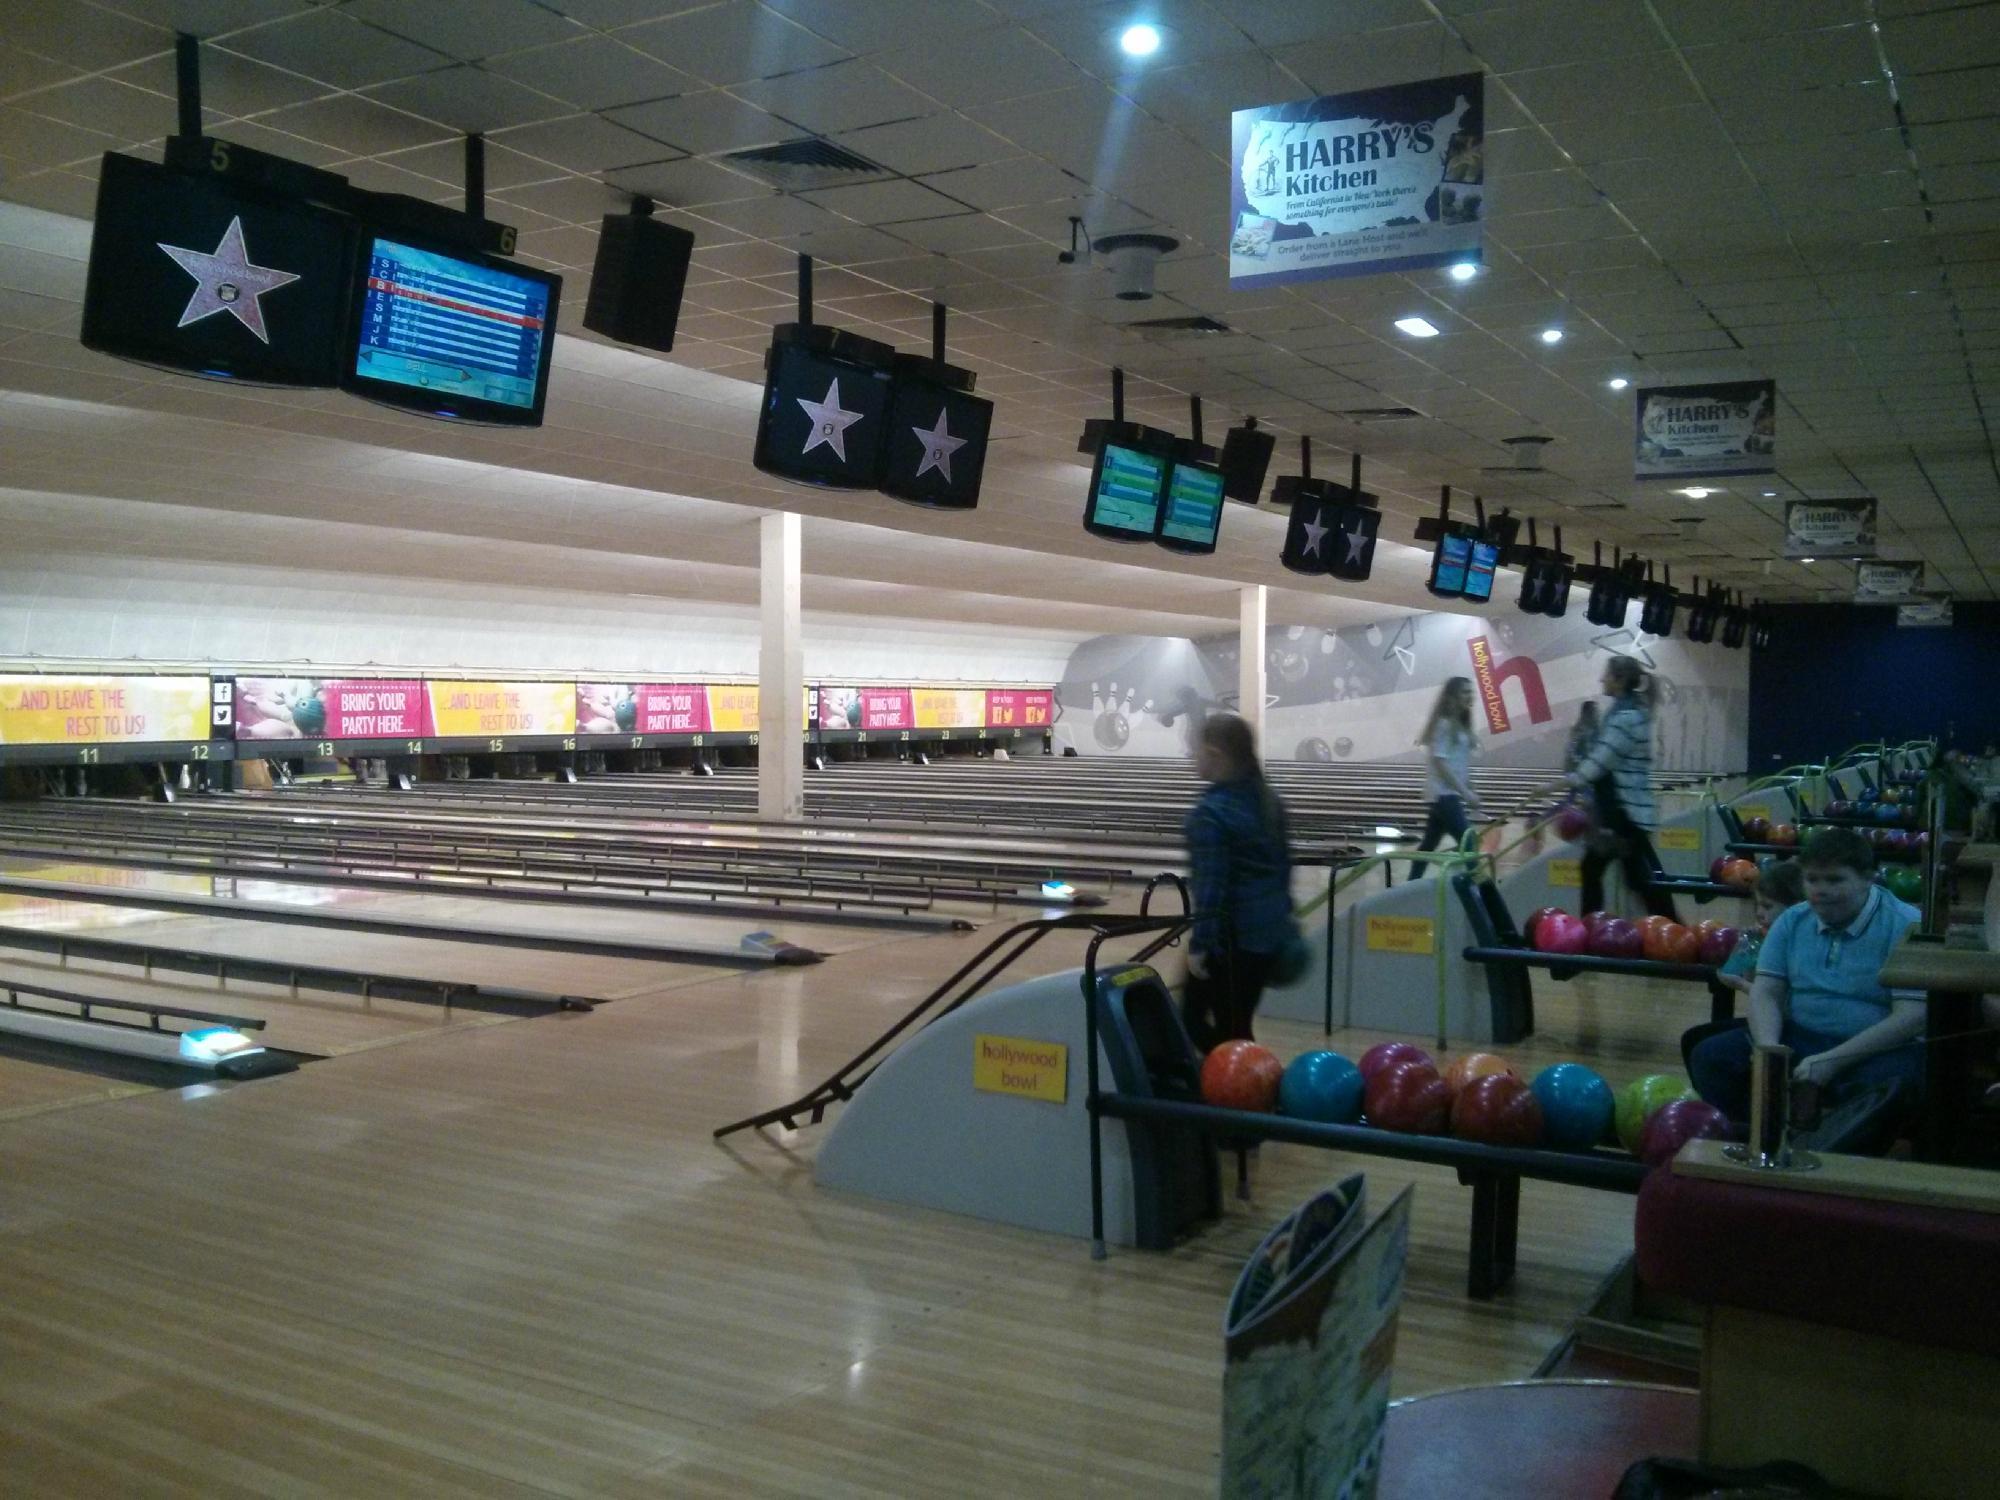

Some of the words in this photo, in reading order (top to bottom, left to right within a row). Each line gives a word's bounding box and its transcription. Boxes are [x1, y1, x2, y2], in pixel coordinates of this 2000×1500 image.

[1286, 121, 1436, 172] HARRY'S
[211, 141, 229, 172] 5
[1286, 167, 1378, 197] Kitchen
[501, 228, 516, 253] 6
[1472, 641, 1498, 700] hollywood
[1488, 700, 1507, 729] bowl
[56, 690, 94, 710] LEAVE
[100, 689, 125, 709] THE
[341, 694, 375, 712] BRING
[377, 692, 406, 710] YOUR
[647, 696, 671, 712] BRING
[672, 695, 692, 711] YOUR
[66, 717, 99, 736] REST
[103, 716, 120, 735] TO
[125, 715, 145, 735] US!
[342, 716, 376, 735] PARTY
[480, 714, 503, 731] REST
[505, 714, 517, 730] TO
[647, 715, 671, 731] PARTY
[407, 741, 422, 754] 14
[489, 739, 503, 751] 15
[562, 738, 575, 750] 16
[631, 737, 643, 748] 17
[692, 735, 703, 746] 18
[749, 734, 759, 745] 19
[80, 748, 99, 763] 11
[191, 745, 209, 760] 12
[317, 742, 333, 756] 13
[982, 1040, 1058, 1069] hollywood
